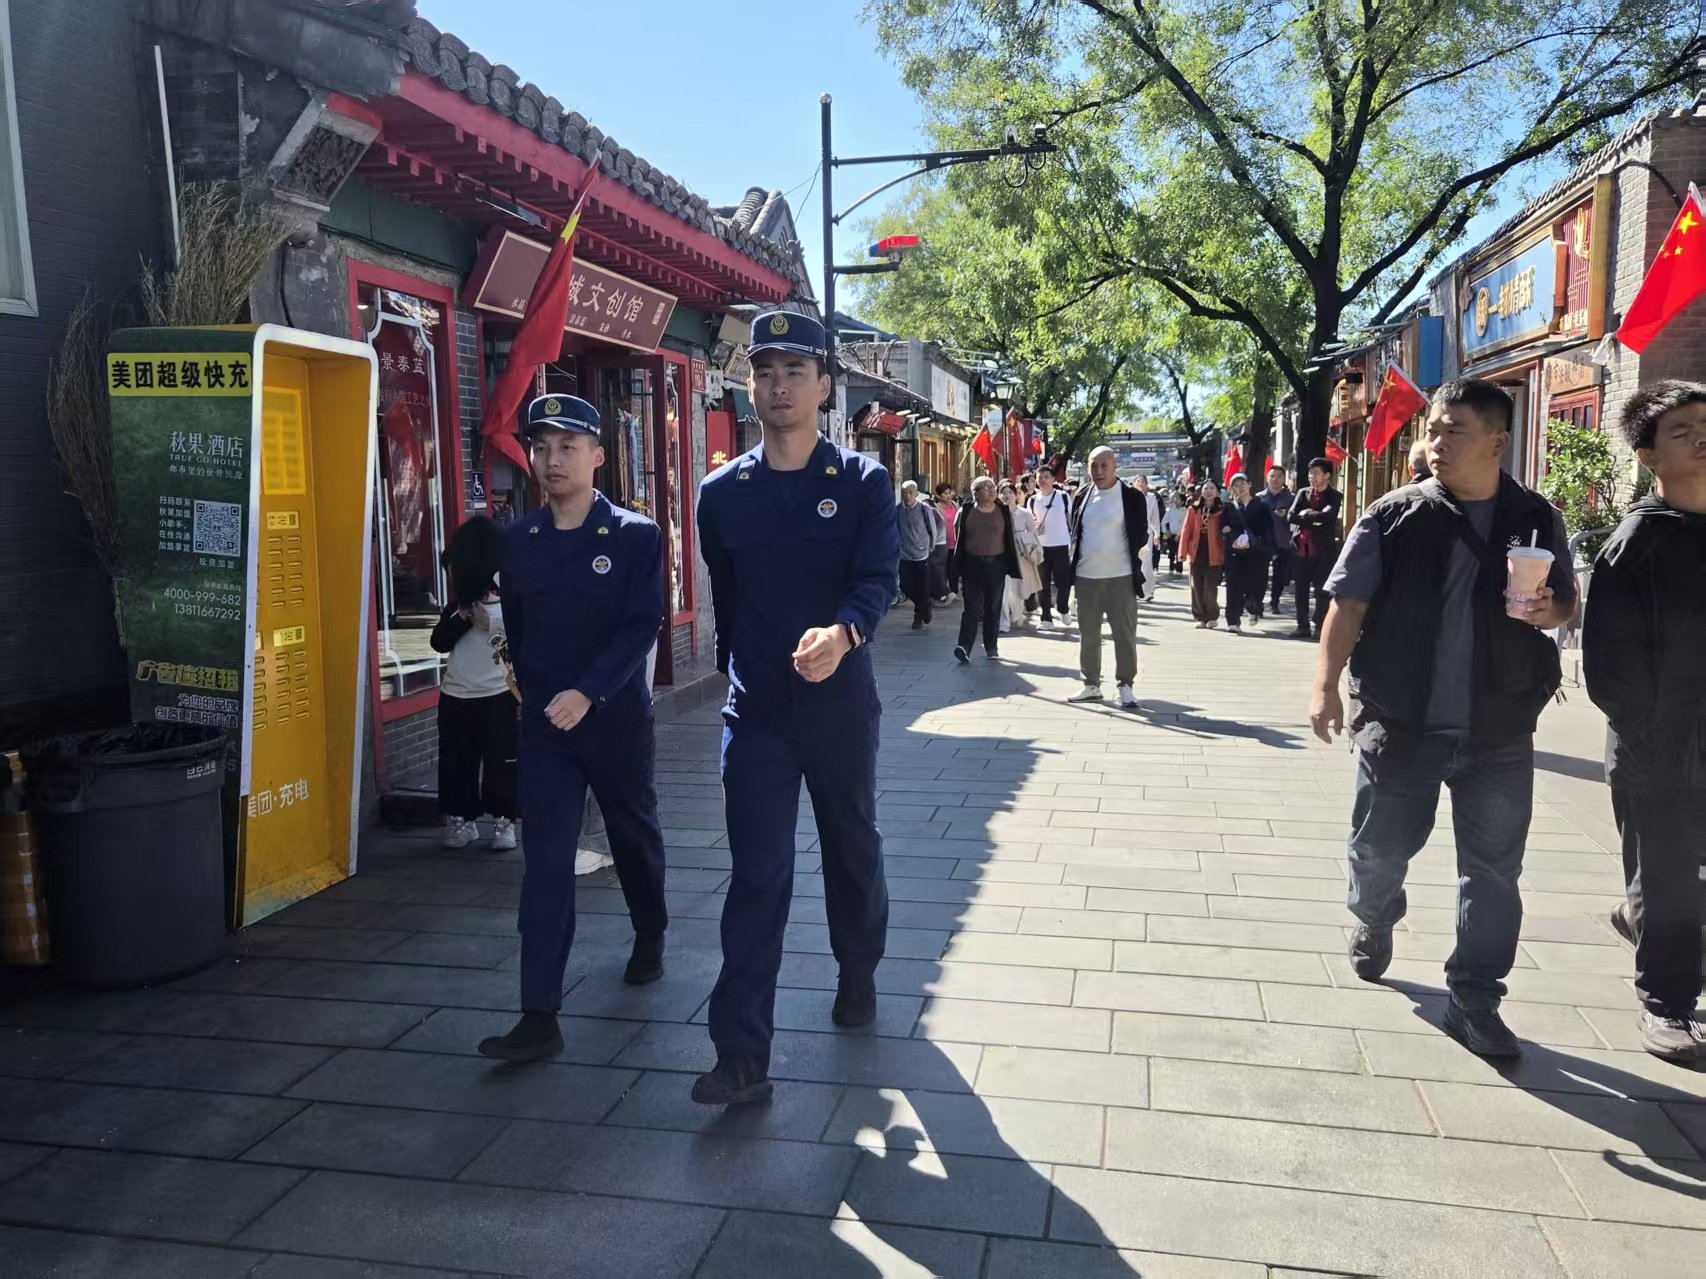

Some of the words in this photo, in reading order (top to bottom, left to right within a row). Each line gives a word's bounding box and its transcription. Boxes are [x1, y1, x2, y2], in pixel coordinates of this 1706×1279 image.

[111, 360, 249, 389] 美团超级快充
[169, 431, 243, 458] 秋果酒店
[170, 454, 192, 463] TRUE
[164, 588, 241, 606] 4000-999-682
[174, 603, 241, 621] 13811667292
[136, 660, 239, 692] 广告位招租
